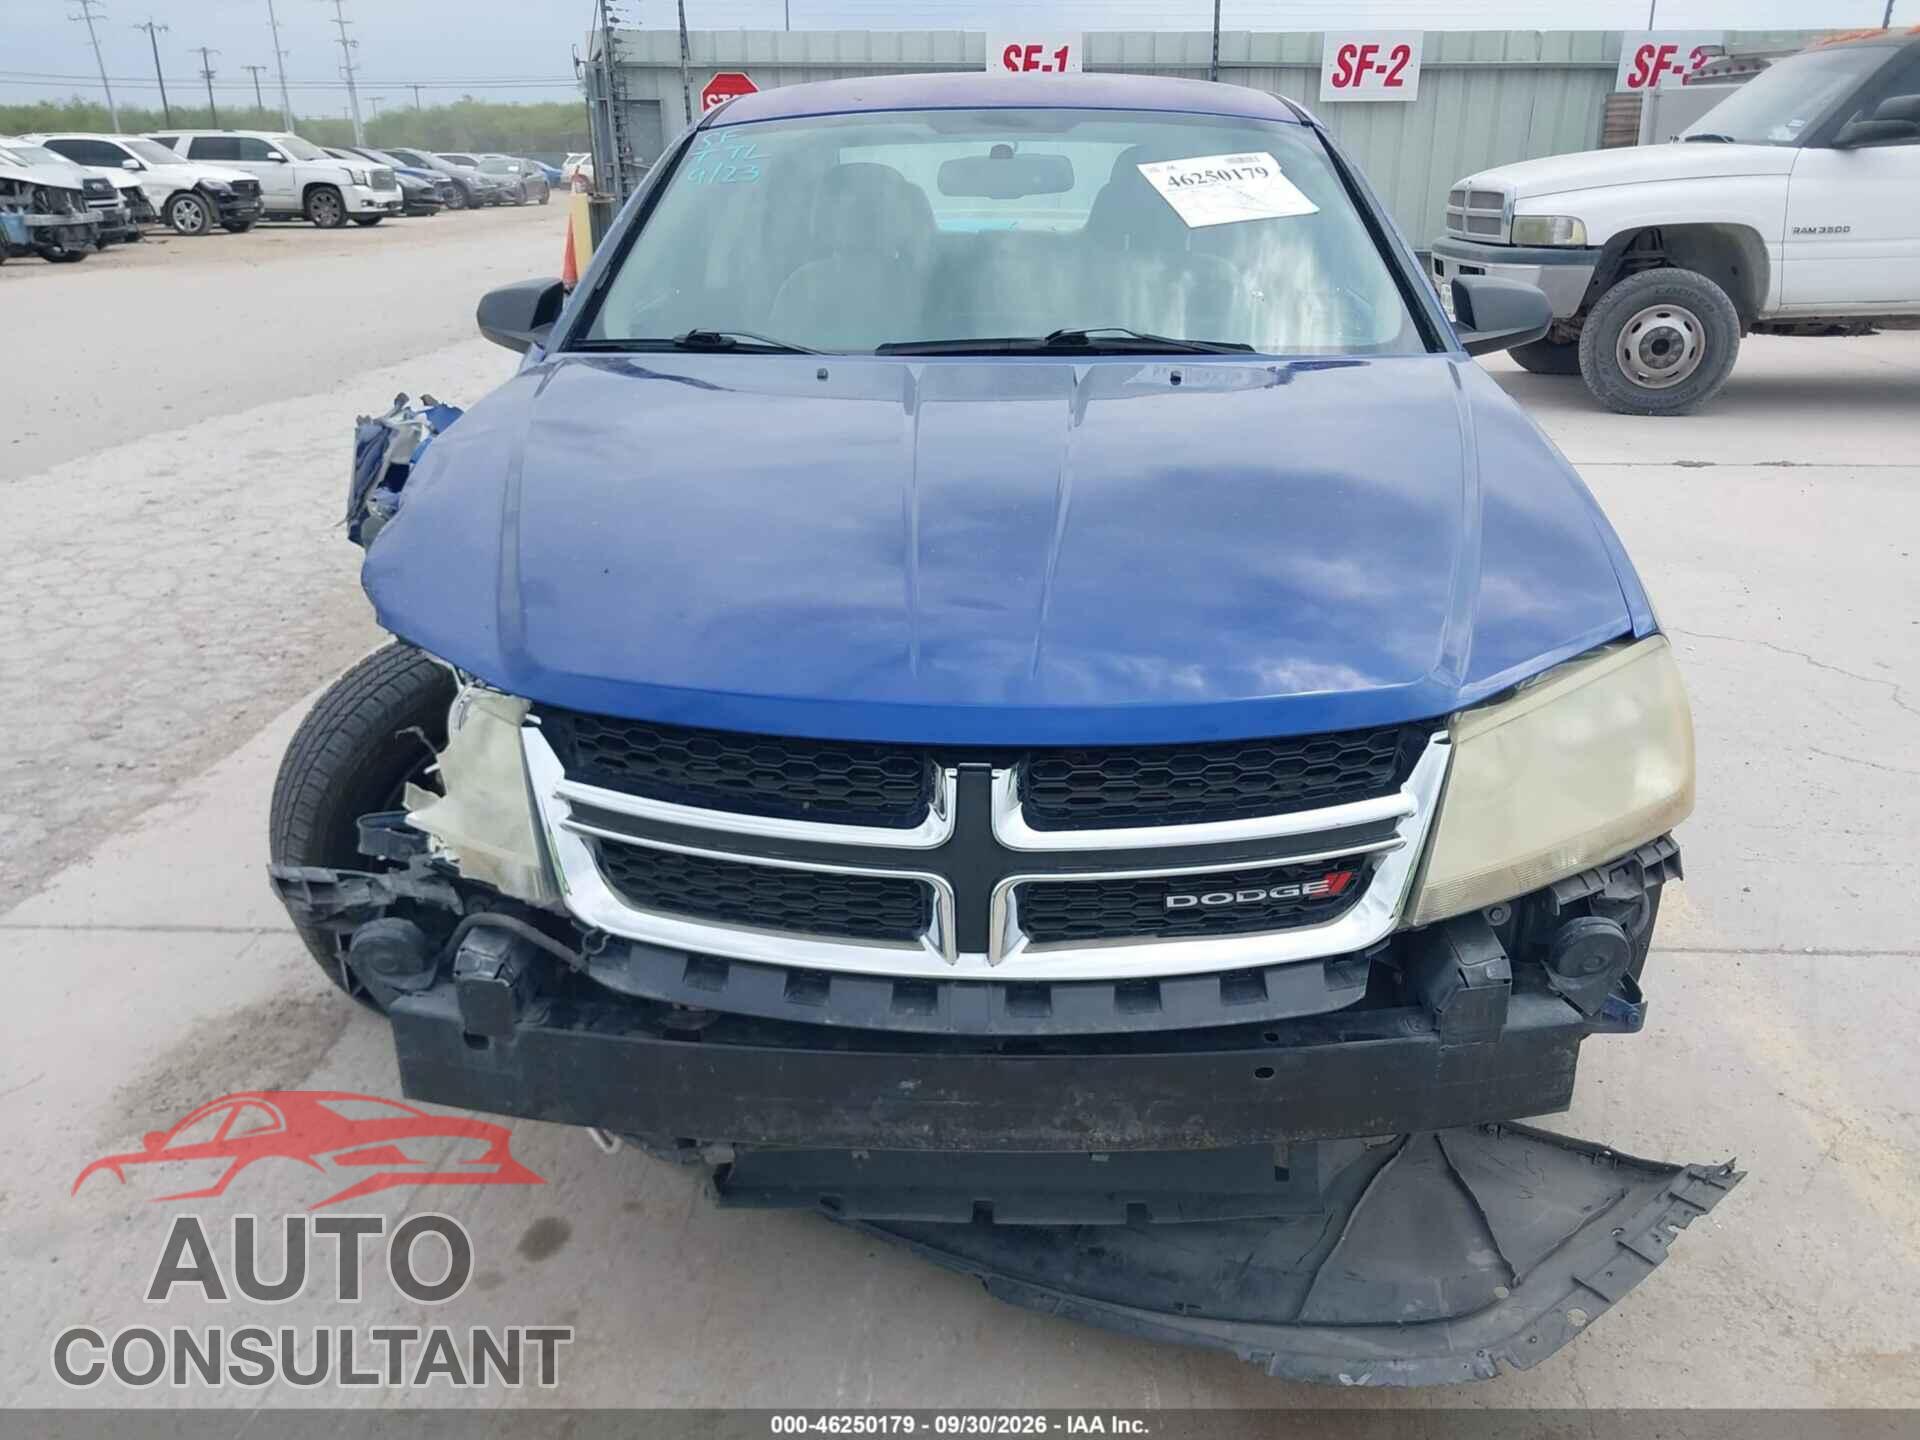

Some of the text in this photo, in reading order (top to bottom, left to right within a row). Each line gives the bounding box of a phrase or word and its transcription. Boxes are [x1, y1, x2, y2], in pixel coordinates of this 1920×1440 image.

[1003, 44, 1069, 72] SF-1
[1332, 44, 1411, 88] SF-2
[1167, 166, 1269, 188] 46250179
[1792, 226, 1816, 234] RAM
[1166, 880, 1329, 908] DODGE
